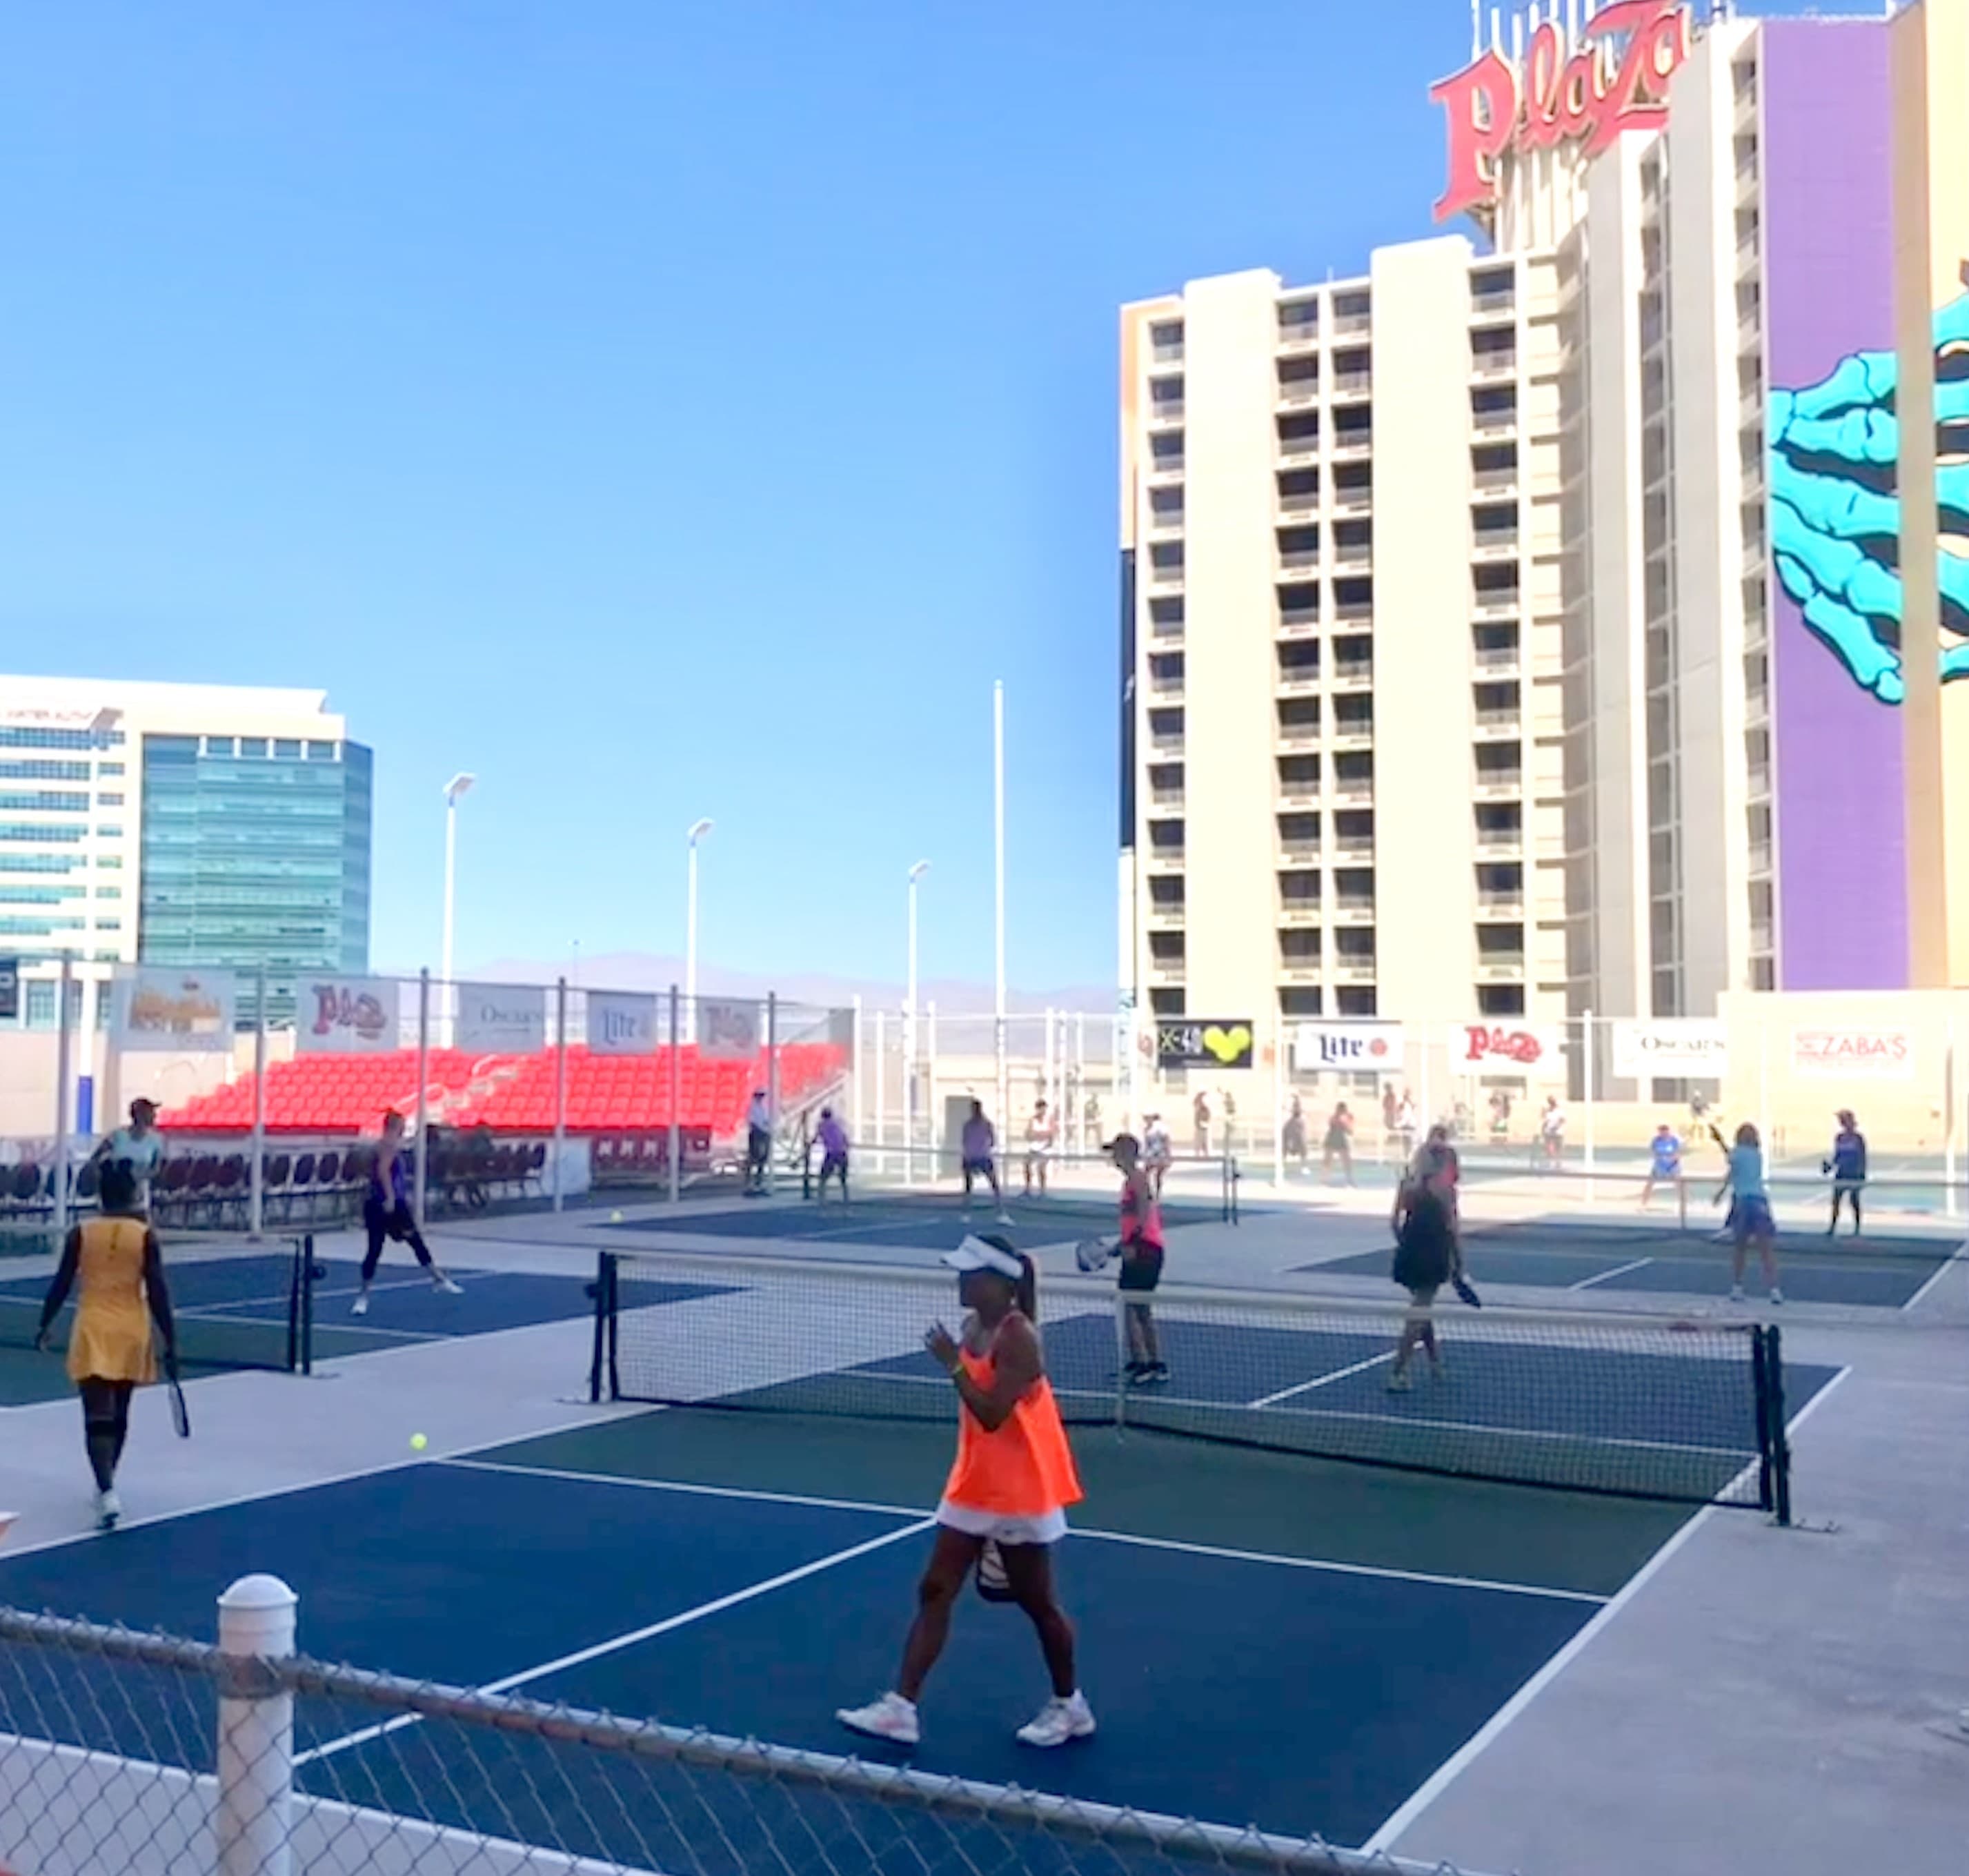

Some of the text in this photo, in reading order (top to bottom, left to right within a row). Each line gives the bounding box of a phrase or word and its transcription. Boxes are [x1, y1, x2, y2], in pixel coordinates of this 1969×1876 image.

[1429, 0, 1690, 224] Plaza
[602, 1007, 636, 1046] Lite
[1320, 1034, 1363, 1063] Lite
